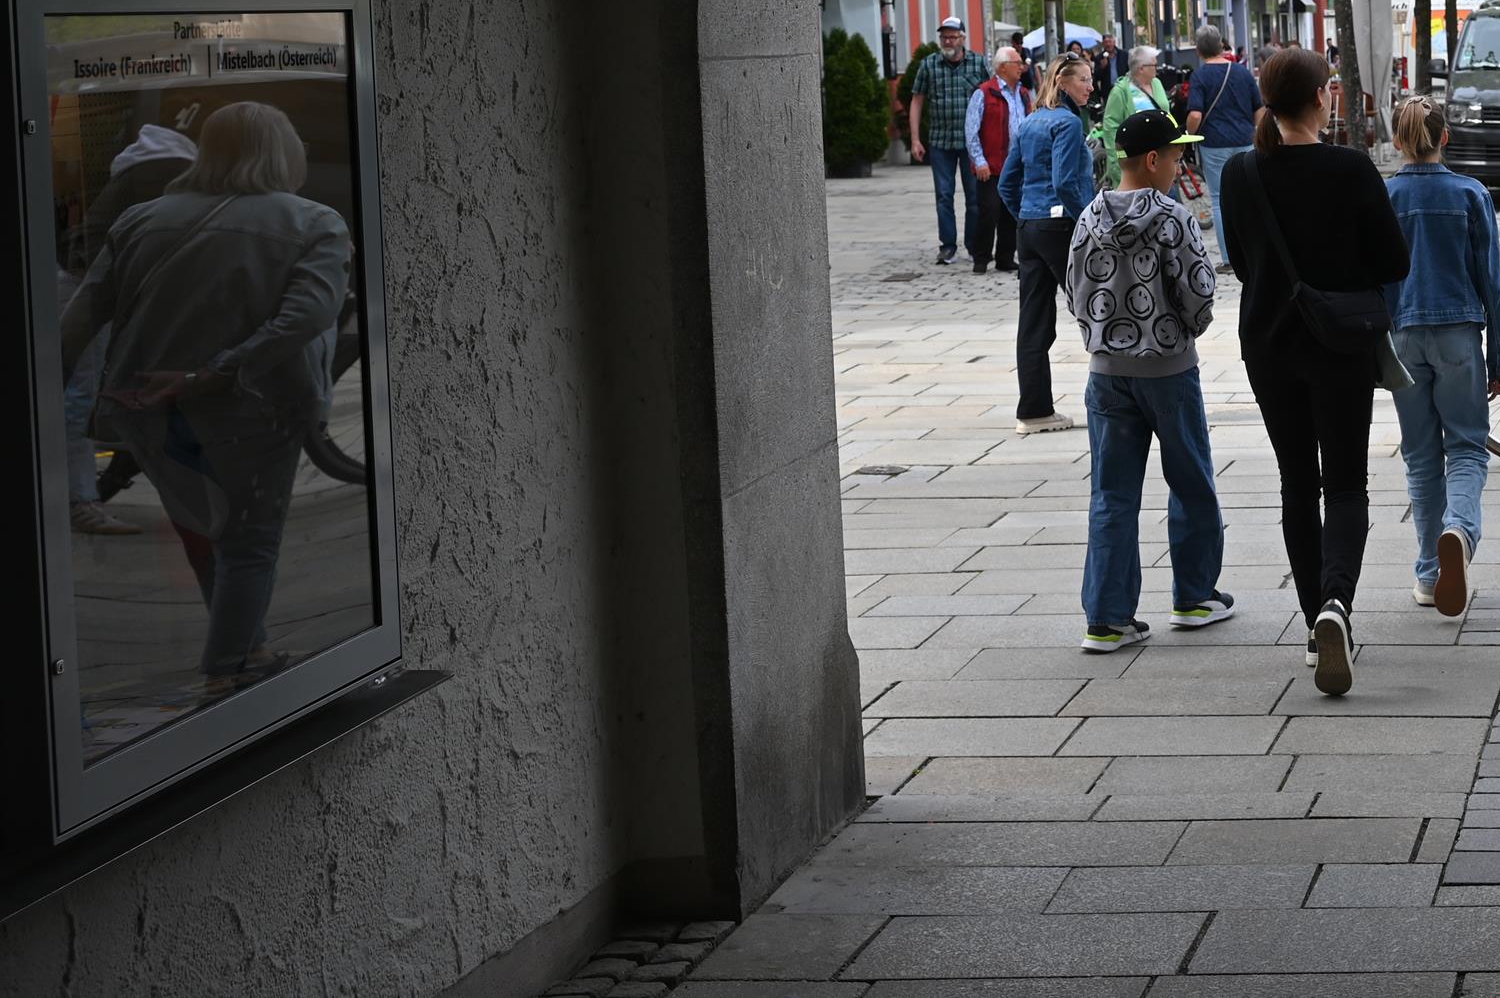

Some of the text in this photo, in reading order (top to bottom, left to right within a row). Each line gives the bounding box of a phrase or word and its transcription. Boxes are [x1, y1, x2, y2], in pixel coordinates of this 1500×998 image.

[173, 20, 242, 40] Partnerstädte
[74, 45, 337, 80] Issoire (Frankreich) Mistelbach (Österreich)
